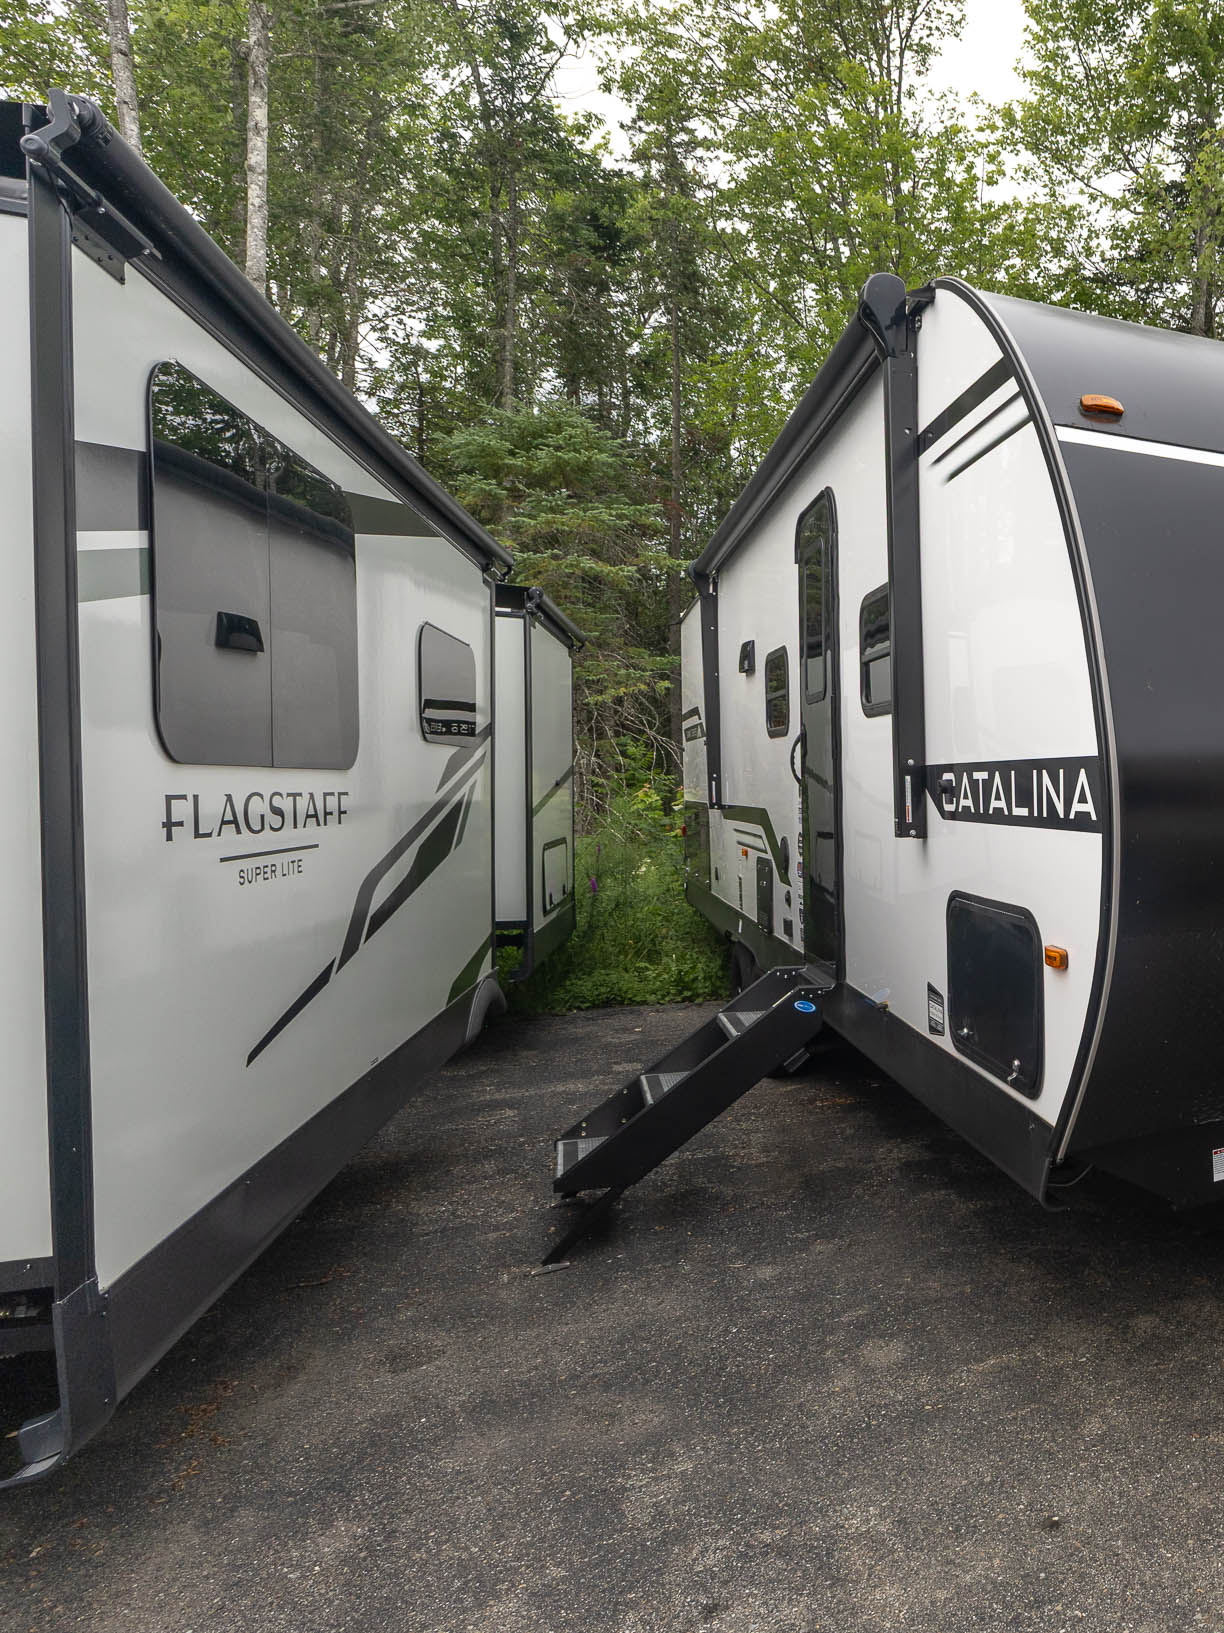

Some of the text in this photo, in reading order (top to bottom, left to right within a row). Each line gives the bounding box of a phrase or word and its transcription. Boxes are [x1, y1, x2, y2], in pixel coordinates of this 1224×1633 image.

[162, 791, 349, 842] FLAGSTAFF
[942, 768, 1097, 821] CATALINA
[238, 859, 303, 886] SUPER LITE
